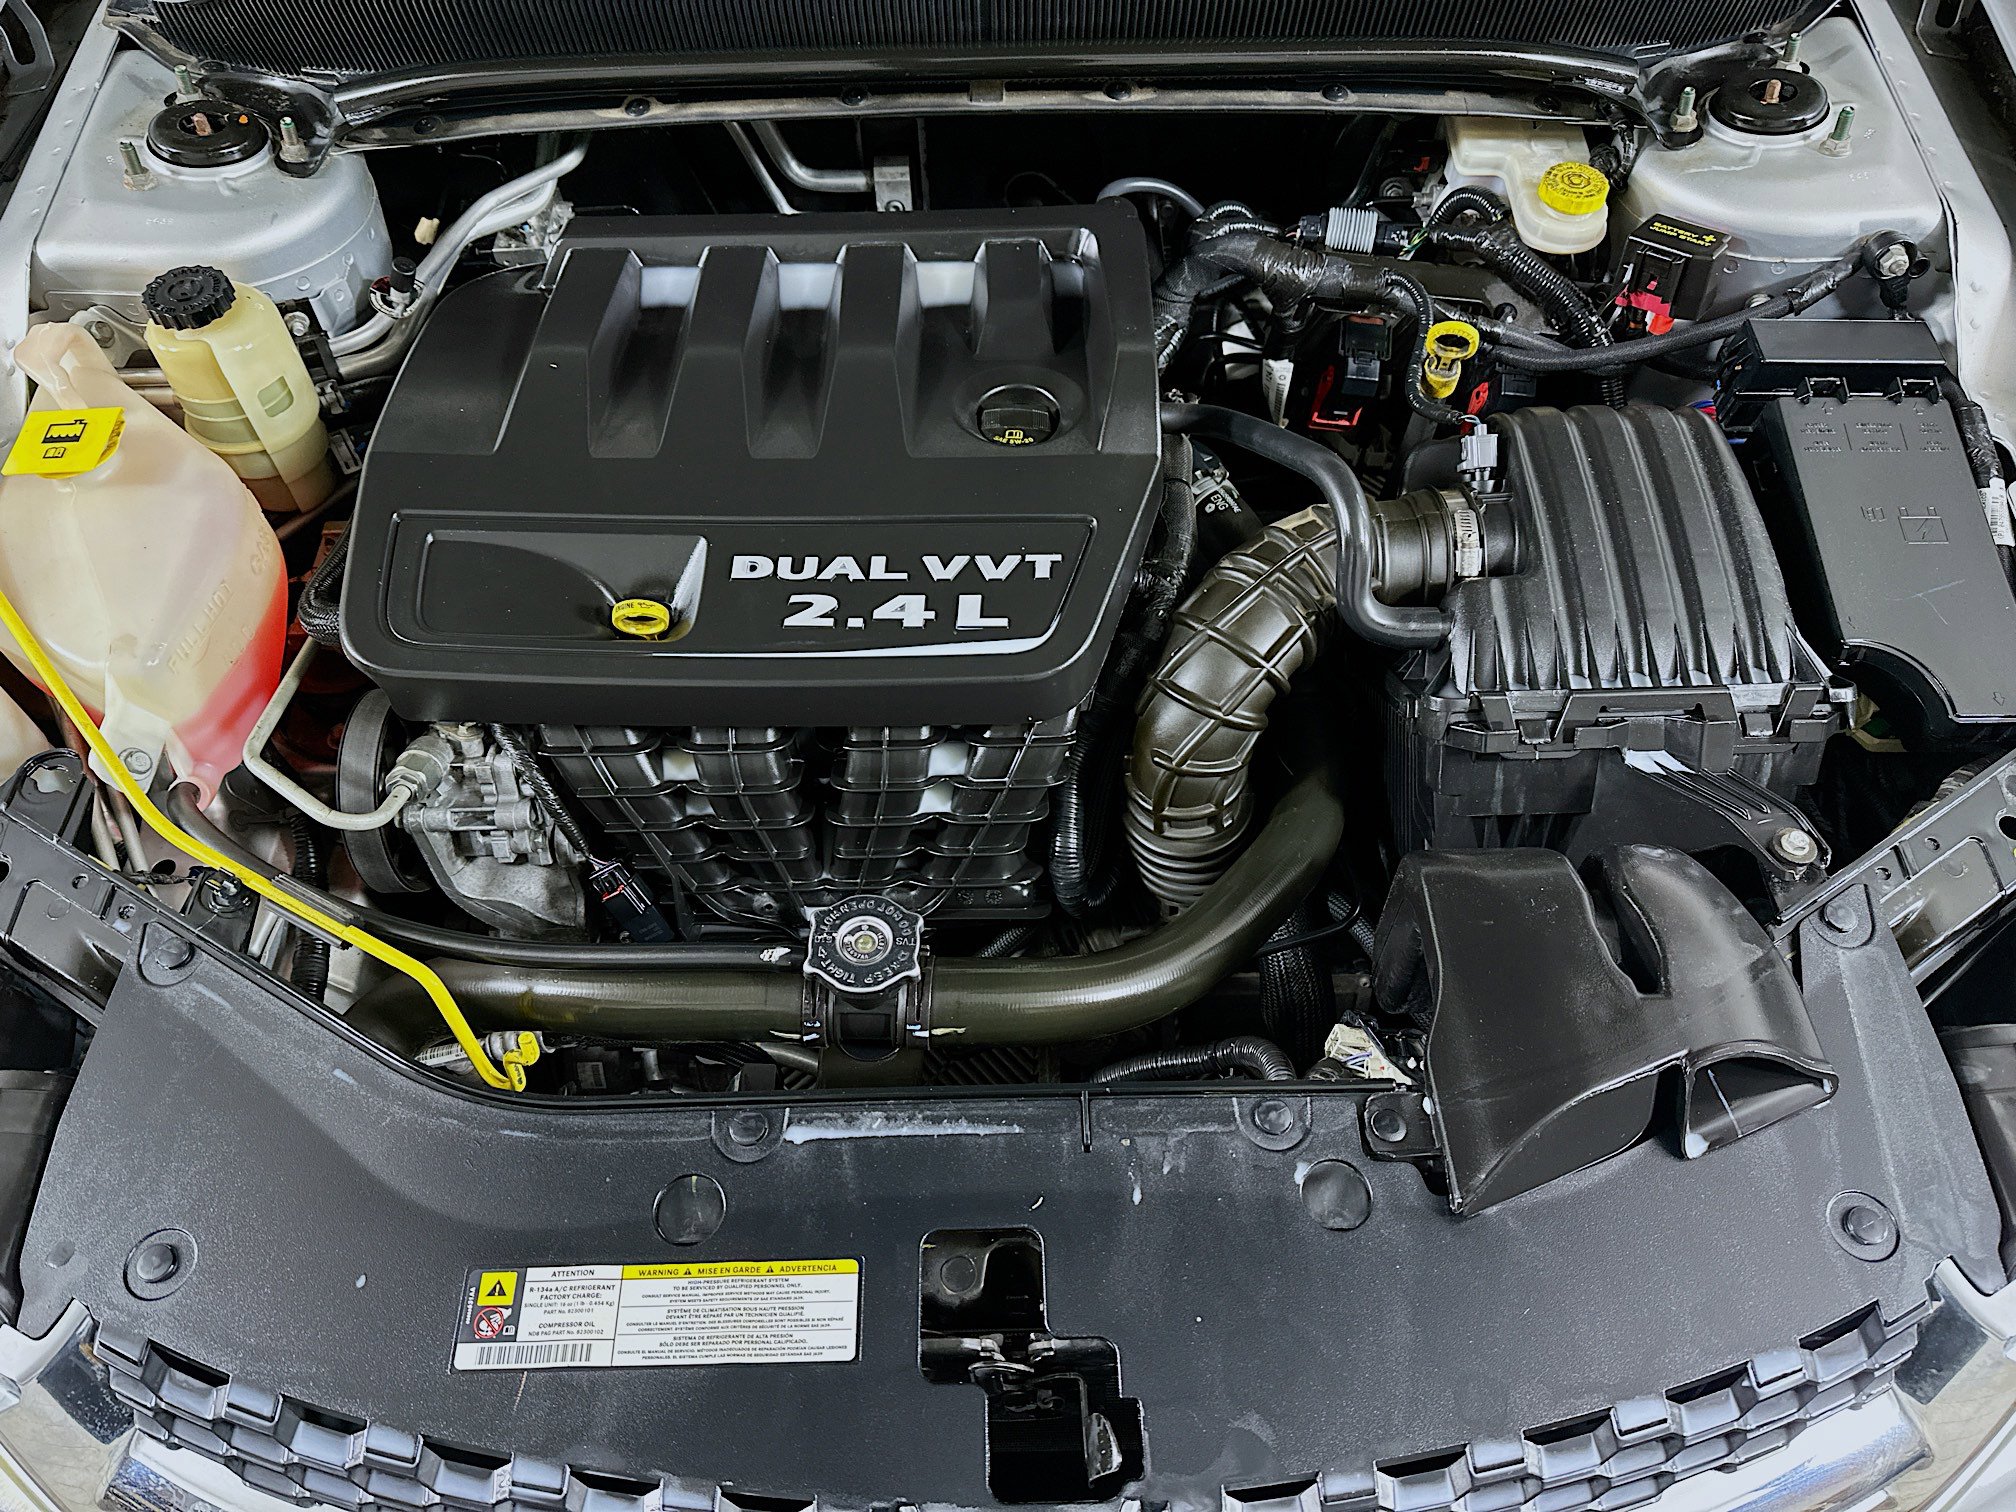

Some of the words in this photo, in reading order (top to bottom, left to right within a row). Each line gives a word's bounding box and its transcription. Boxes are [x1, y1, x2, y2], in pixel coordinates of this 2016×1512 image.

[1650, 226, 1678, 236] JUMP
[1678, 234, 1712, 246] START
[1653, 222, 1699, 238] BATTERY
[993, 436, 1008, 444] SAE
[1212, 494, 1230, 512] ENG
[730, 554, 909, 582] DUAL
[922, 553, 1063, 582] VVT
[782, 593, 936, 630] 2.4
[954, 594, 1010, 631] L
[167, 623, 207, 675] FULL
[203, 579, 233, 621] HOT
[839, 900, 875, 914] OPEN
[876, 904, 904, 922] NOT
[898, 920, 912, 936] DO
[896, 938, 916, 946] TVS
[820, 957, 856, 984] TIGHT
[864, 960, 901, 984] KEEP
